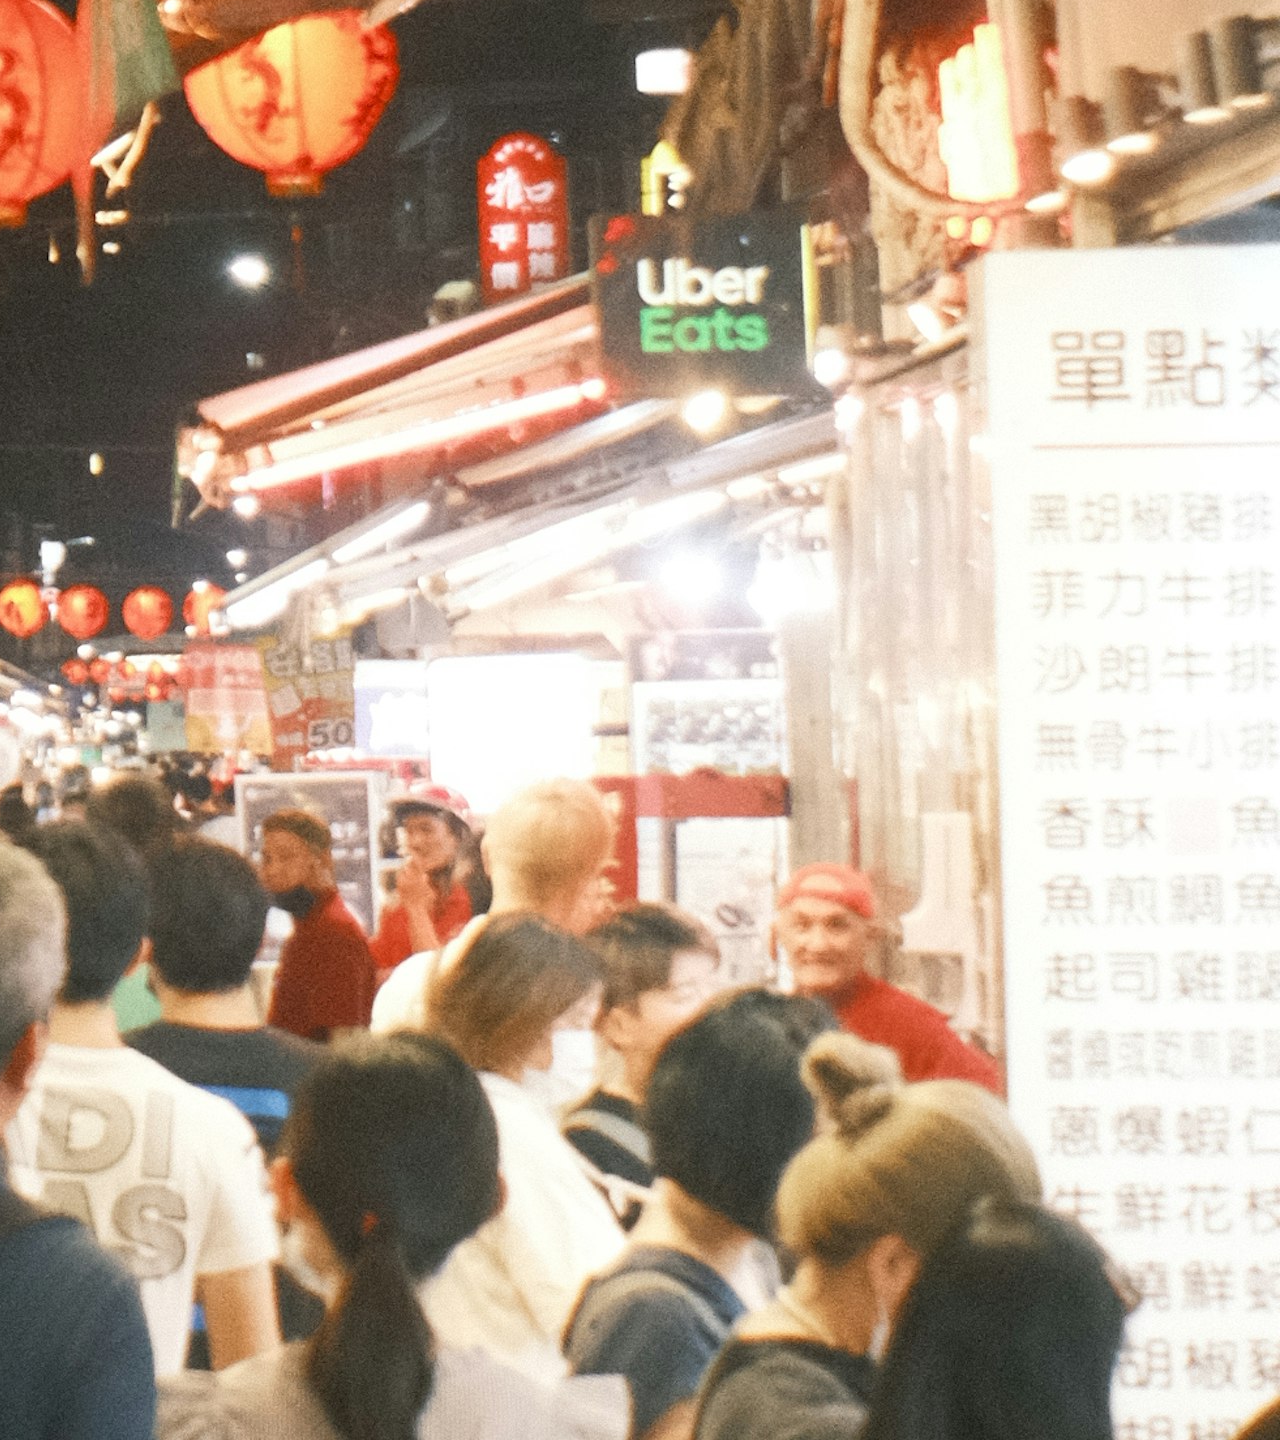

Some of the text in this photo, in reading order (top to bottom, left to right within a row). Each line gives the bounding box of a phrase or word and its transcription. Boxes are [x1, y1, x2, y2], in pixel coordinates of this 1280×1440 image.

[637, 258, 771, 307] Uber
[640, 307, 770, 354] Eats
[1030, 566, 1278, 619] 菲力牛排
[1032, 641, 1280, 695] 沙朗牛排
[307, 721, 353, 748] 50
[1034, 718, 1279, 771] 無骨牛小排
